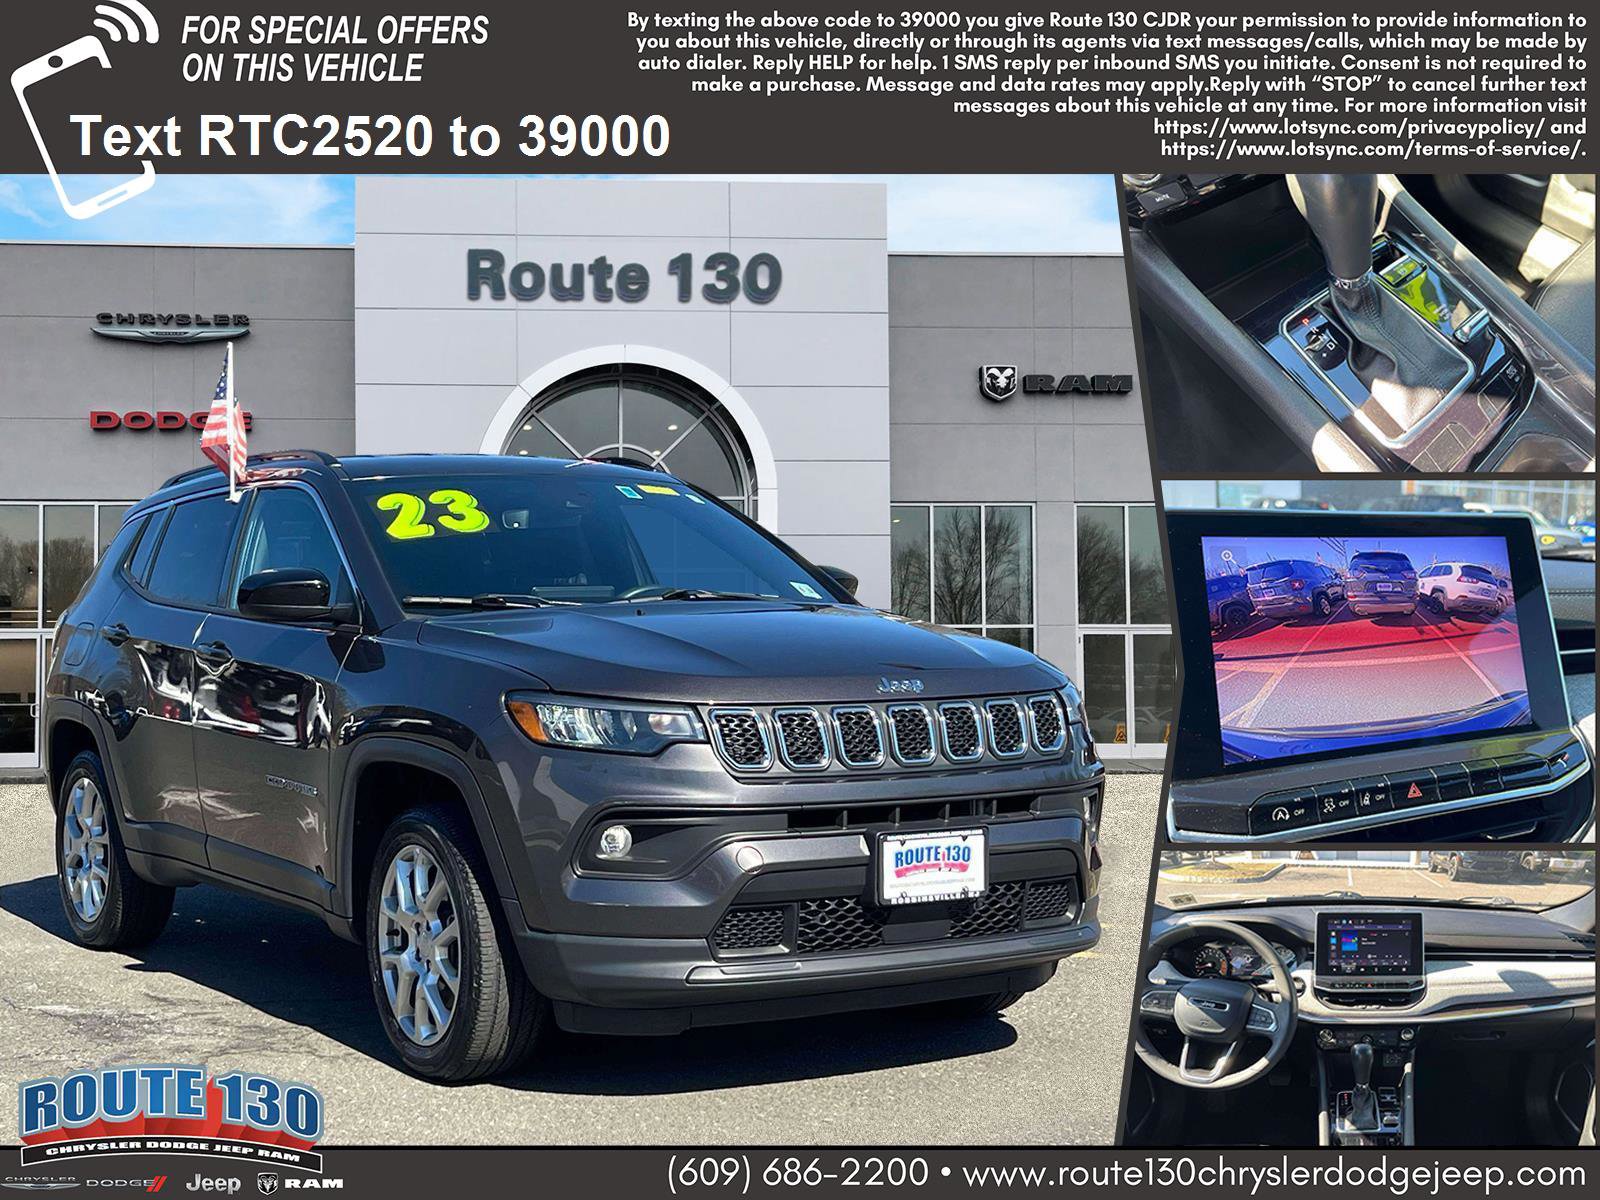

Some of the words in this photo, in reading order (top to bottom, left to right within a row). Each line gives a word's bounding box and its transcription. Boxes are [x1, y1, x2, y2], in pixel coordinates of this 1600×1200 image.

[467, 248, 649, 302] Route
[668, 251, 783, 304] 130
[96, 312, 250, 326] CHRYSLER
[1023, 374, 1133, 394] RAM
[376, 489, 490, 540] 23
[876, 676, 925, 696] Jeep
[894, 846, 941, 868] ROUTE
[945, 845, 971, 862] 130
